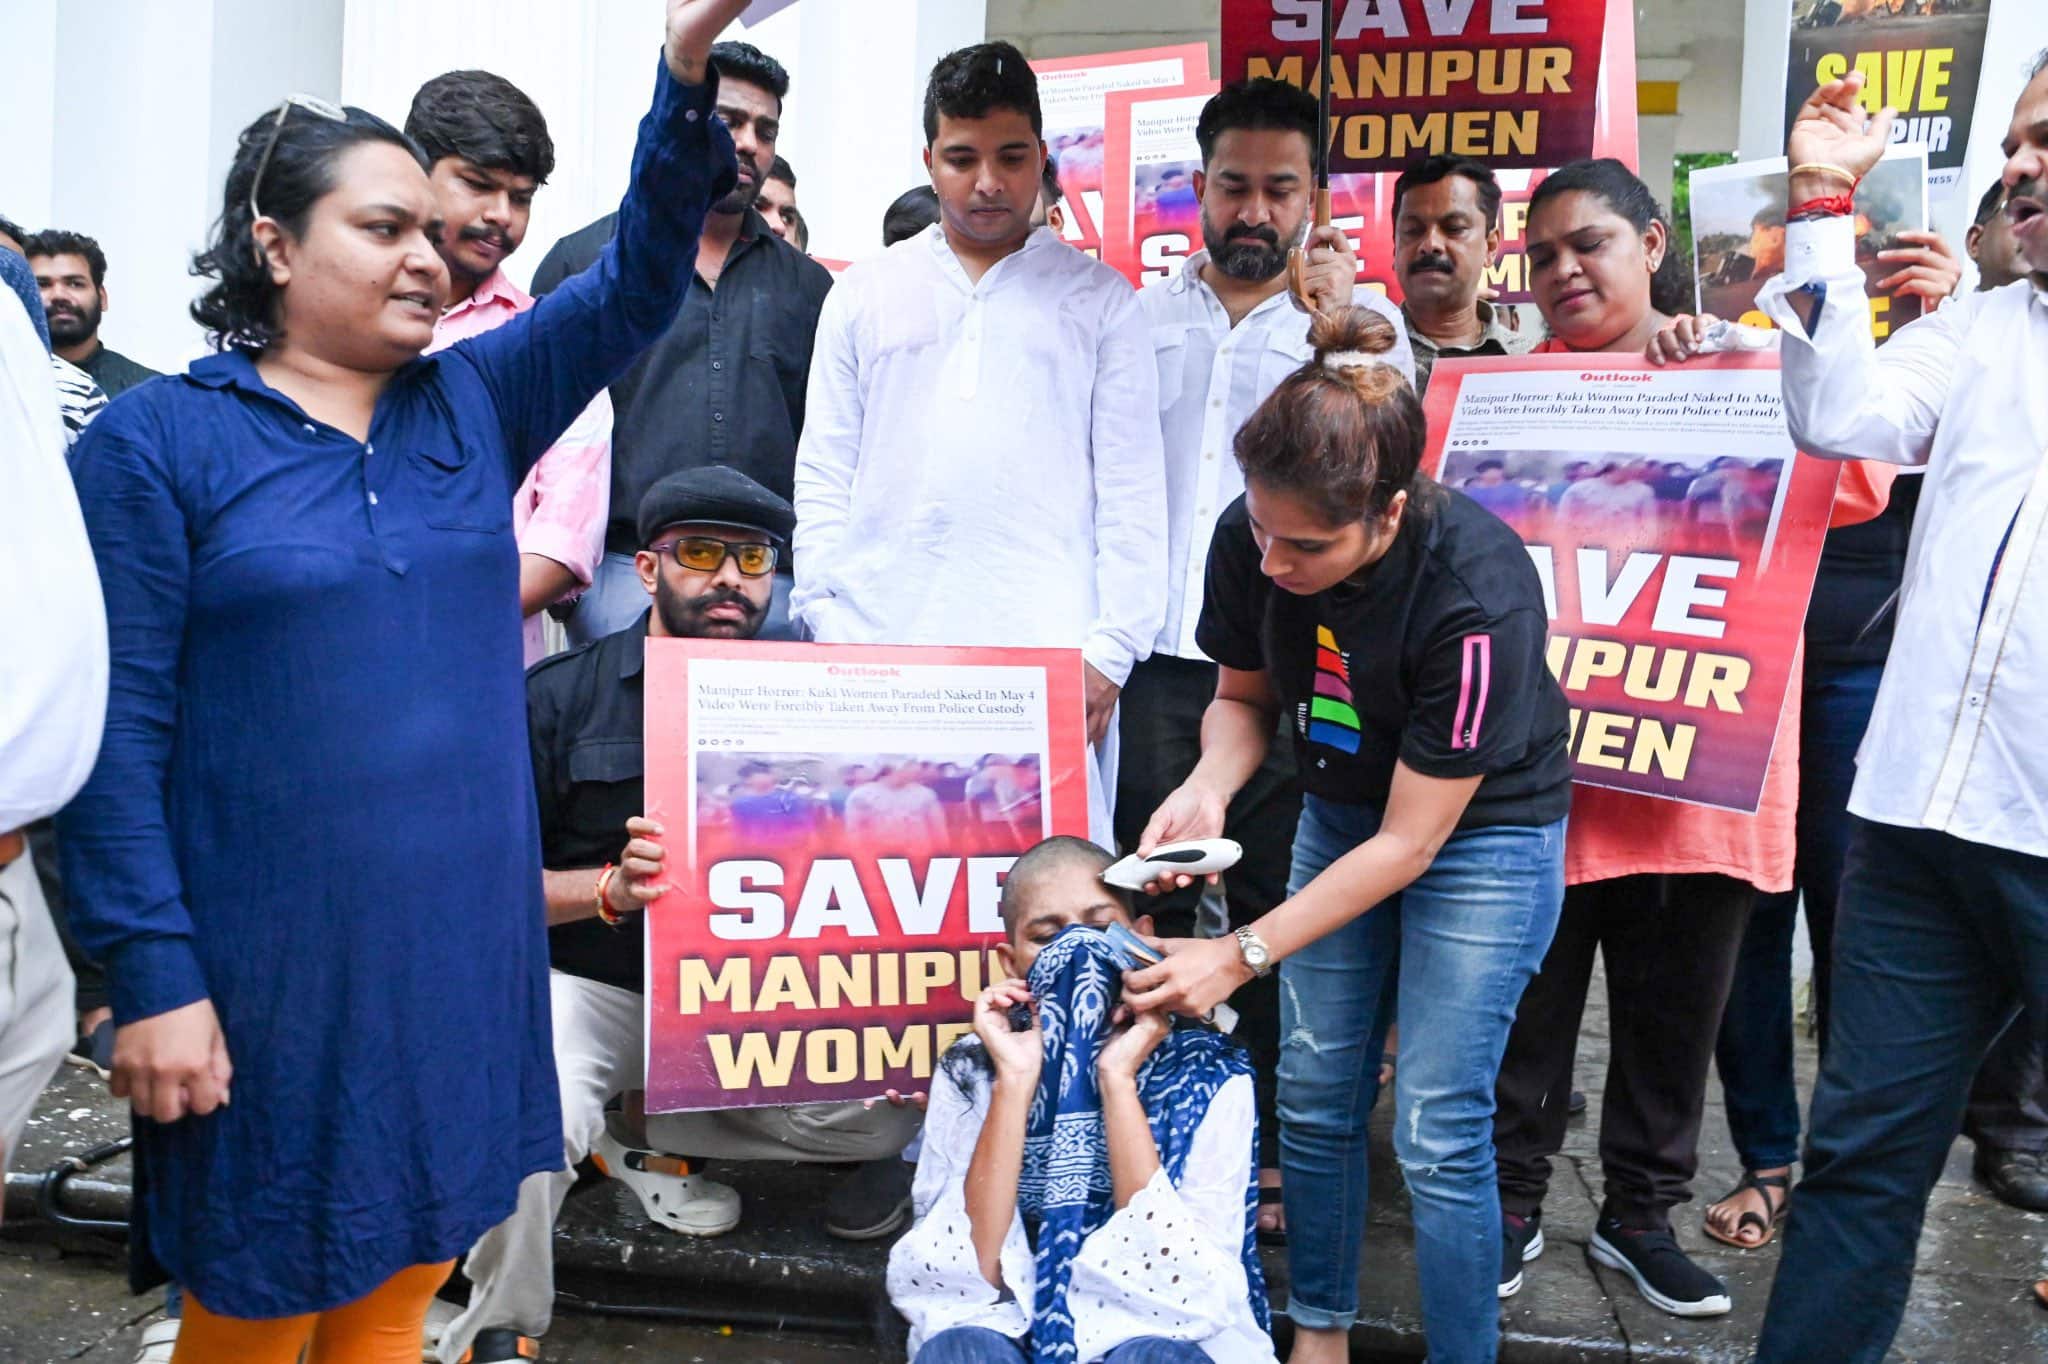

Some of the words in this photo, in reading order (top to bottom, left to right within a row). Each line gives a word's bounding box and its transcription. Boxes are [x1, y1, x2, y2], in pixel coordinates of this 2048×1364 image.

[1329, 110, 1540, 160] OMEN
[1580, 373, 1654, 383] Outlook
[1464, 394, 1510, 405] Manipur
[1512, 392, 1553, 402] Horror:
[1556, 392, 1583, 402] Kuki
[1587, 392, 1633, 402] Women
[1636, 392, 1689, 403] Paraded
[1691, 392, 1734, 403] Naked
[1736, 393, 1751, 403] In
[1754, 393, 1782, 405] May
[1461, 406, 1490, 416] Video
[1493, 405, 1520, 415] Were
[1522, 404, 1568, 417] Forcibly
[1571, 404, 1606, 415] Taken
[1608, 405, 1642, 417] Away
[1645, 405, 1678, 416] From
[1682, 405, 1722, 416] Police
[1725, 406, 1781, 420] Custody
[827, 665, 901, 678] Outlook
[698, 684, 754, 698] Manipur
[808, 687, 837, 698] Kuki
[840, 687, 889, 699] Women
[891, 689, 941, 700] Paraded
[944, 689, 982, 700] Naked
[985, 690, 997, 700] In
[1001, 690, 1025, 703] May
[1028, 690, 1035, 700] 4
[698, 698, 735, 710] Video
[738, 699, 771, 711] Were
[775, 700, 824, 713] Forcibly
[827, 701, 864, 713] Taken
[868, 702, 900, 716] Away
[903, 702, 935, 713] From
[938, 702, 975, 714] Police
[978, 702, 1026, 717] Custody
[707, 856, 1020, 941] SAVE
[678, 950, 1006, 1015] MANIPU
